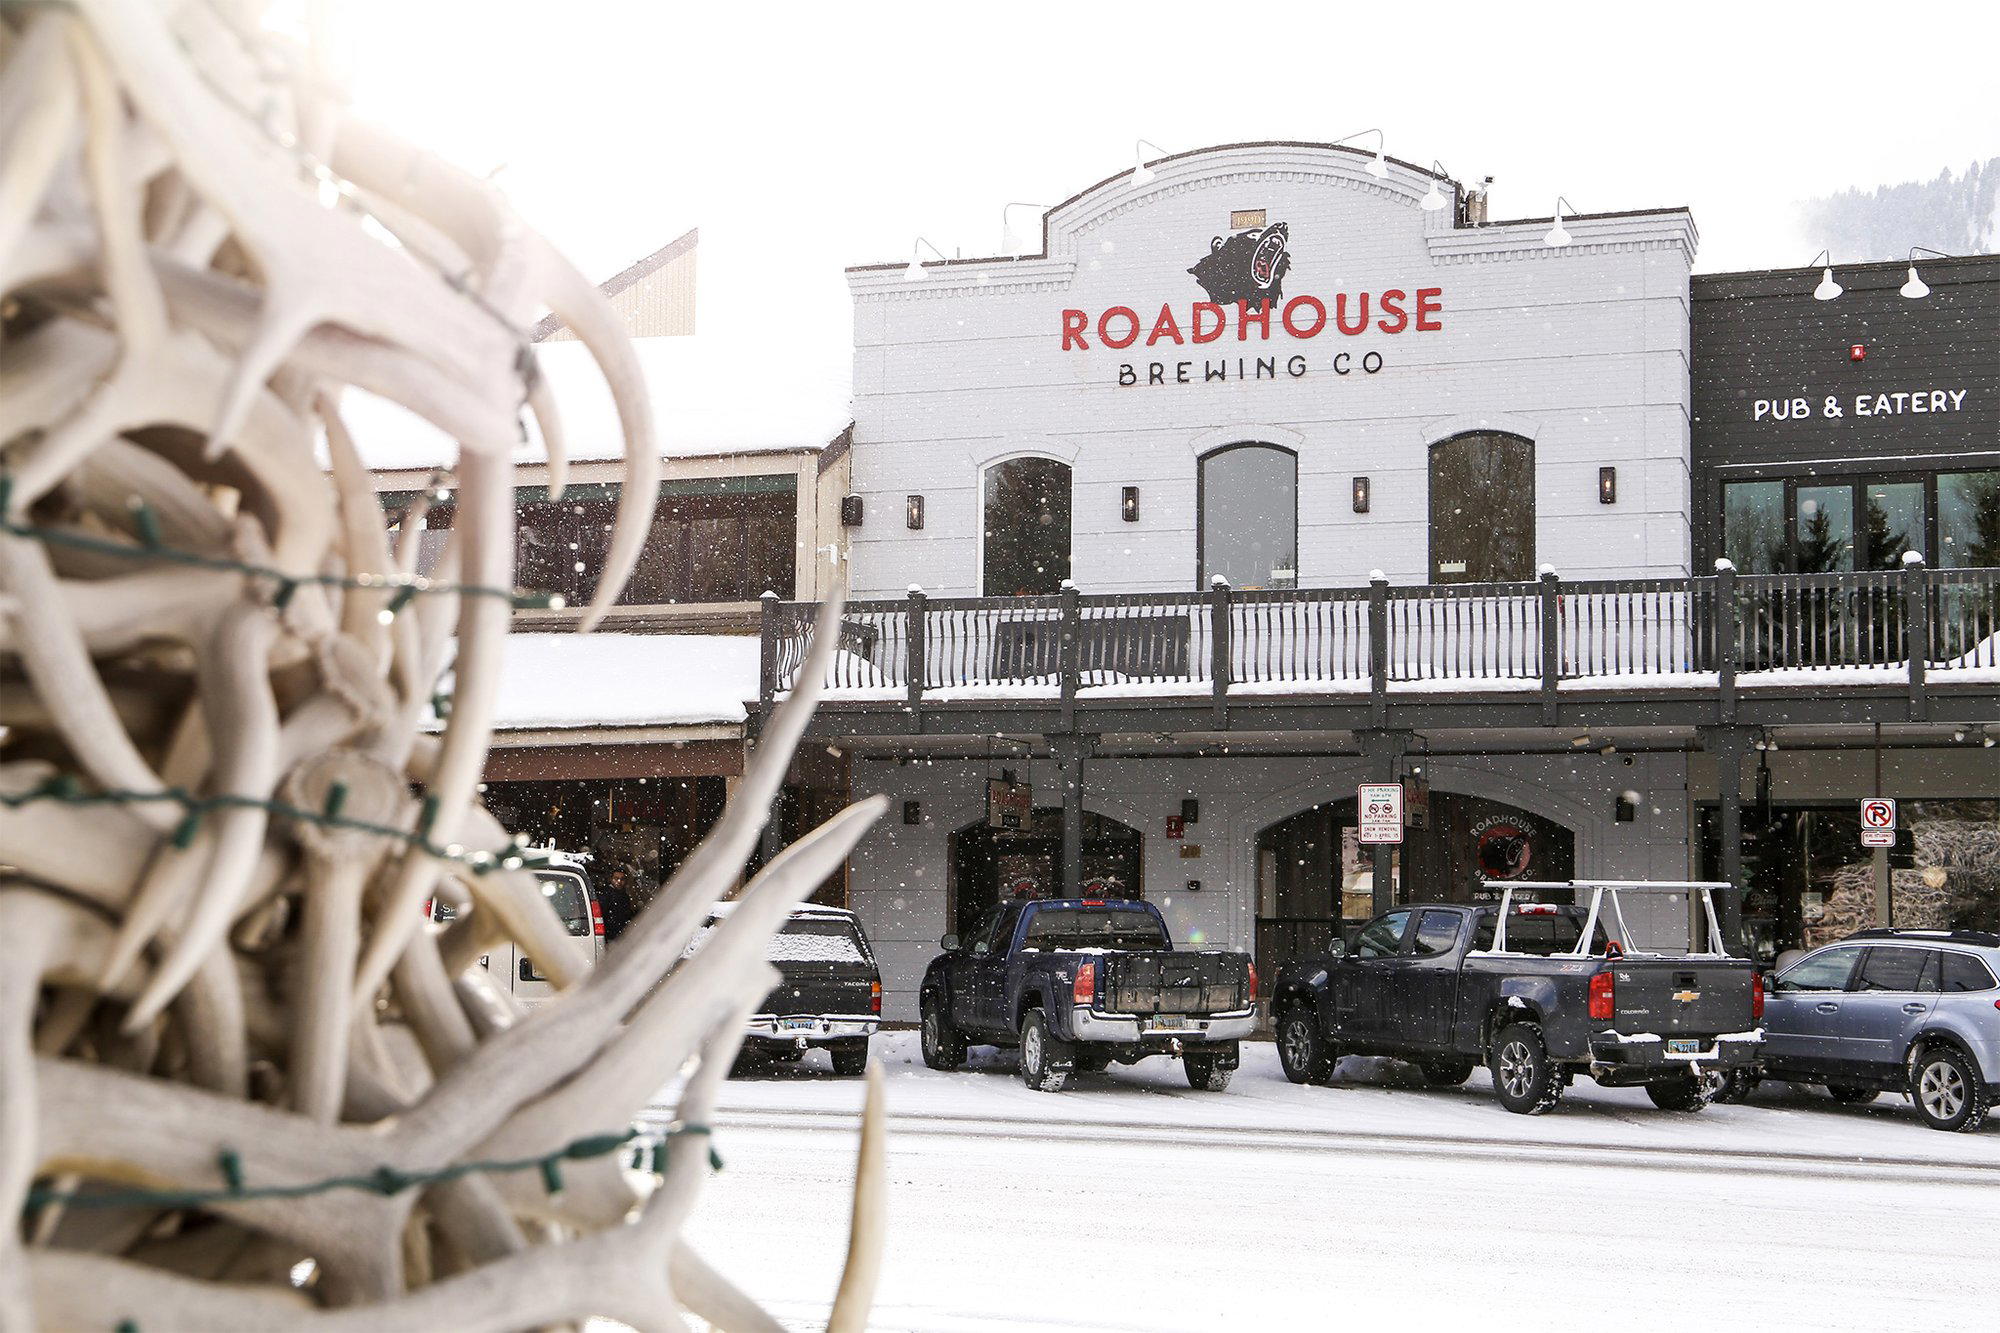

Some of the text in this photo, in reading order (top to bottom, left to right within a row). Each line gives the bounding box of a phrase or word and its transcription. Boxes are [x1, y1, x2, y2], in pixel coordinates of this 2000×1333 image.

[1061, 287, 1442, 351] ROADHOUSE
[1119, 351, 1384, 387] BREWING CO
[1754, 389, 1967, 421] PUB & EATERY
[1470, 814, 1537, 837] ROADHOUSE
